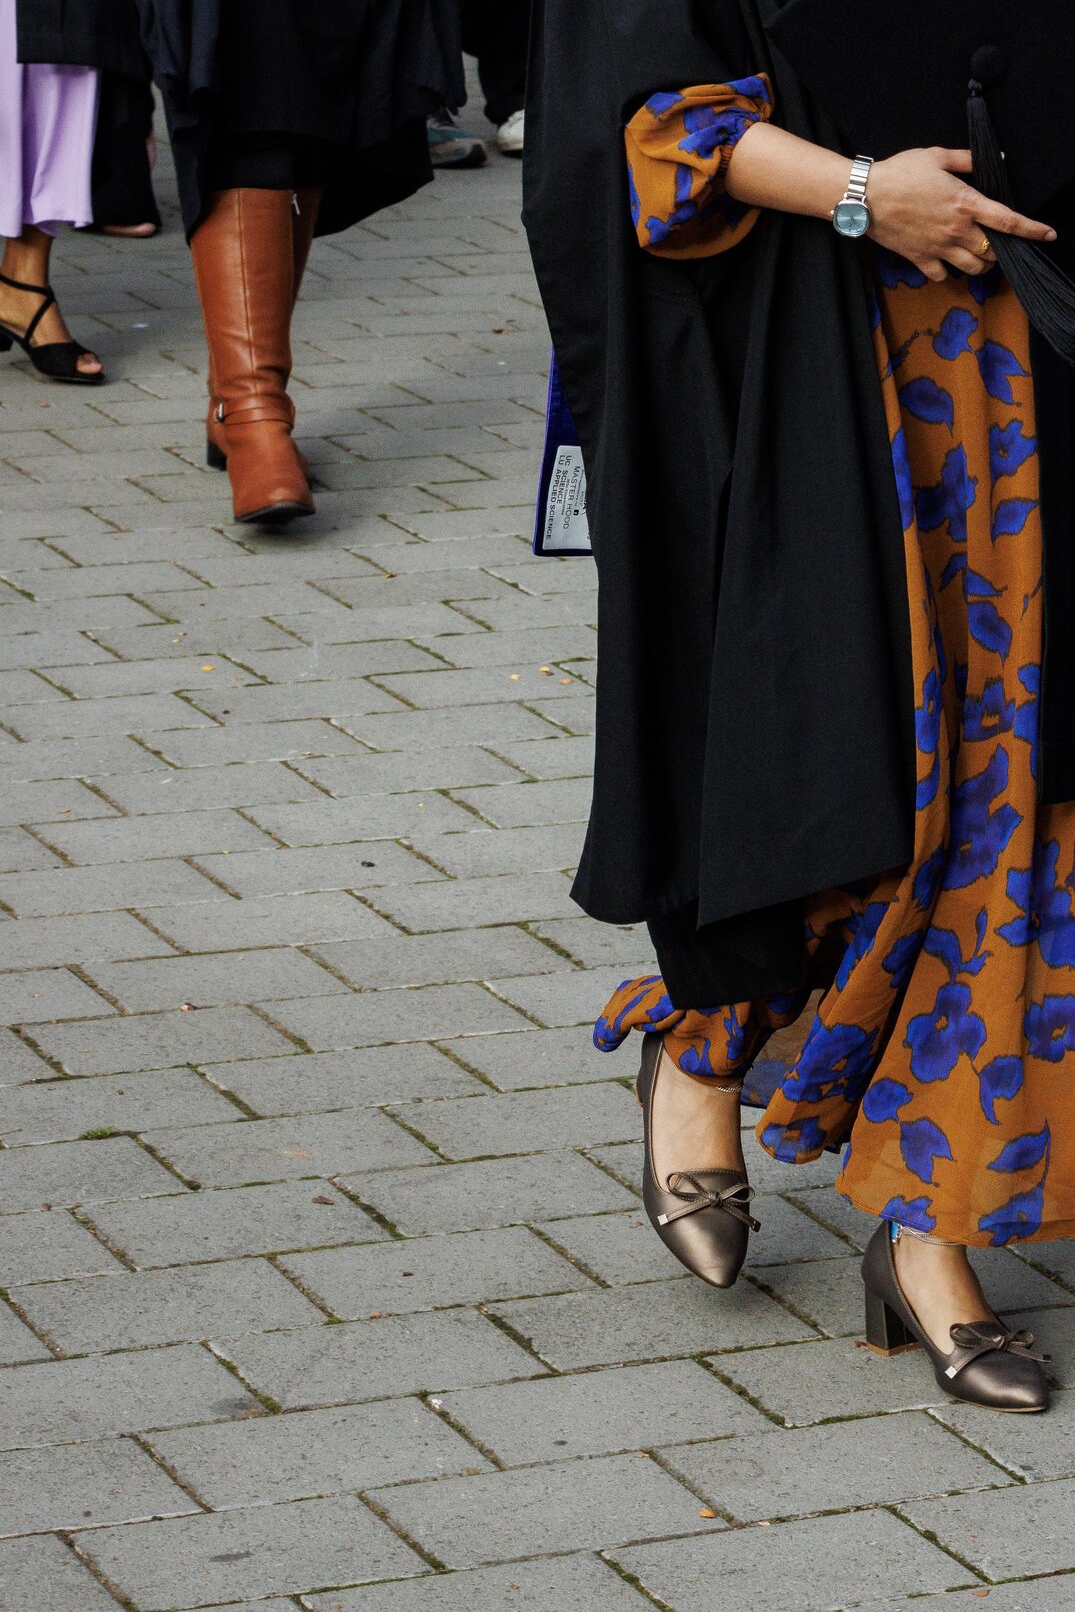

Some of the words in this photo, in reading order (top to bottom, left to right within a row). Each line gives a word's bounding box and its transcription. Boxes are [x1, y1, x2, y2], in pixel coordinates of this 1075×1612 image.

[565, 455, 573, 466] UC
[551, 468, 562, 503] APPLIED
[557, 469, 569, 505] SCIENCE
[567, 465, 581, 501] MASTER
[546, 504, 556, 540] SCIENCE
[563, 503, 573, 530] HOOD
